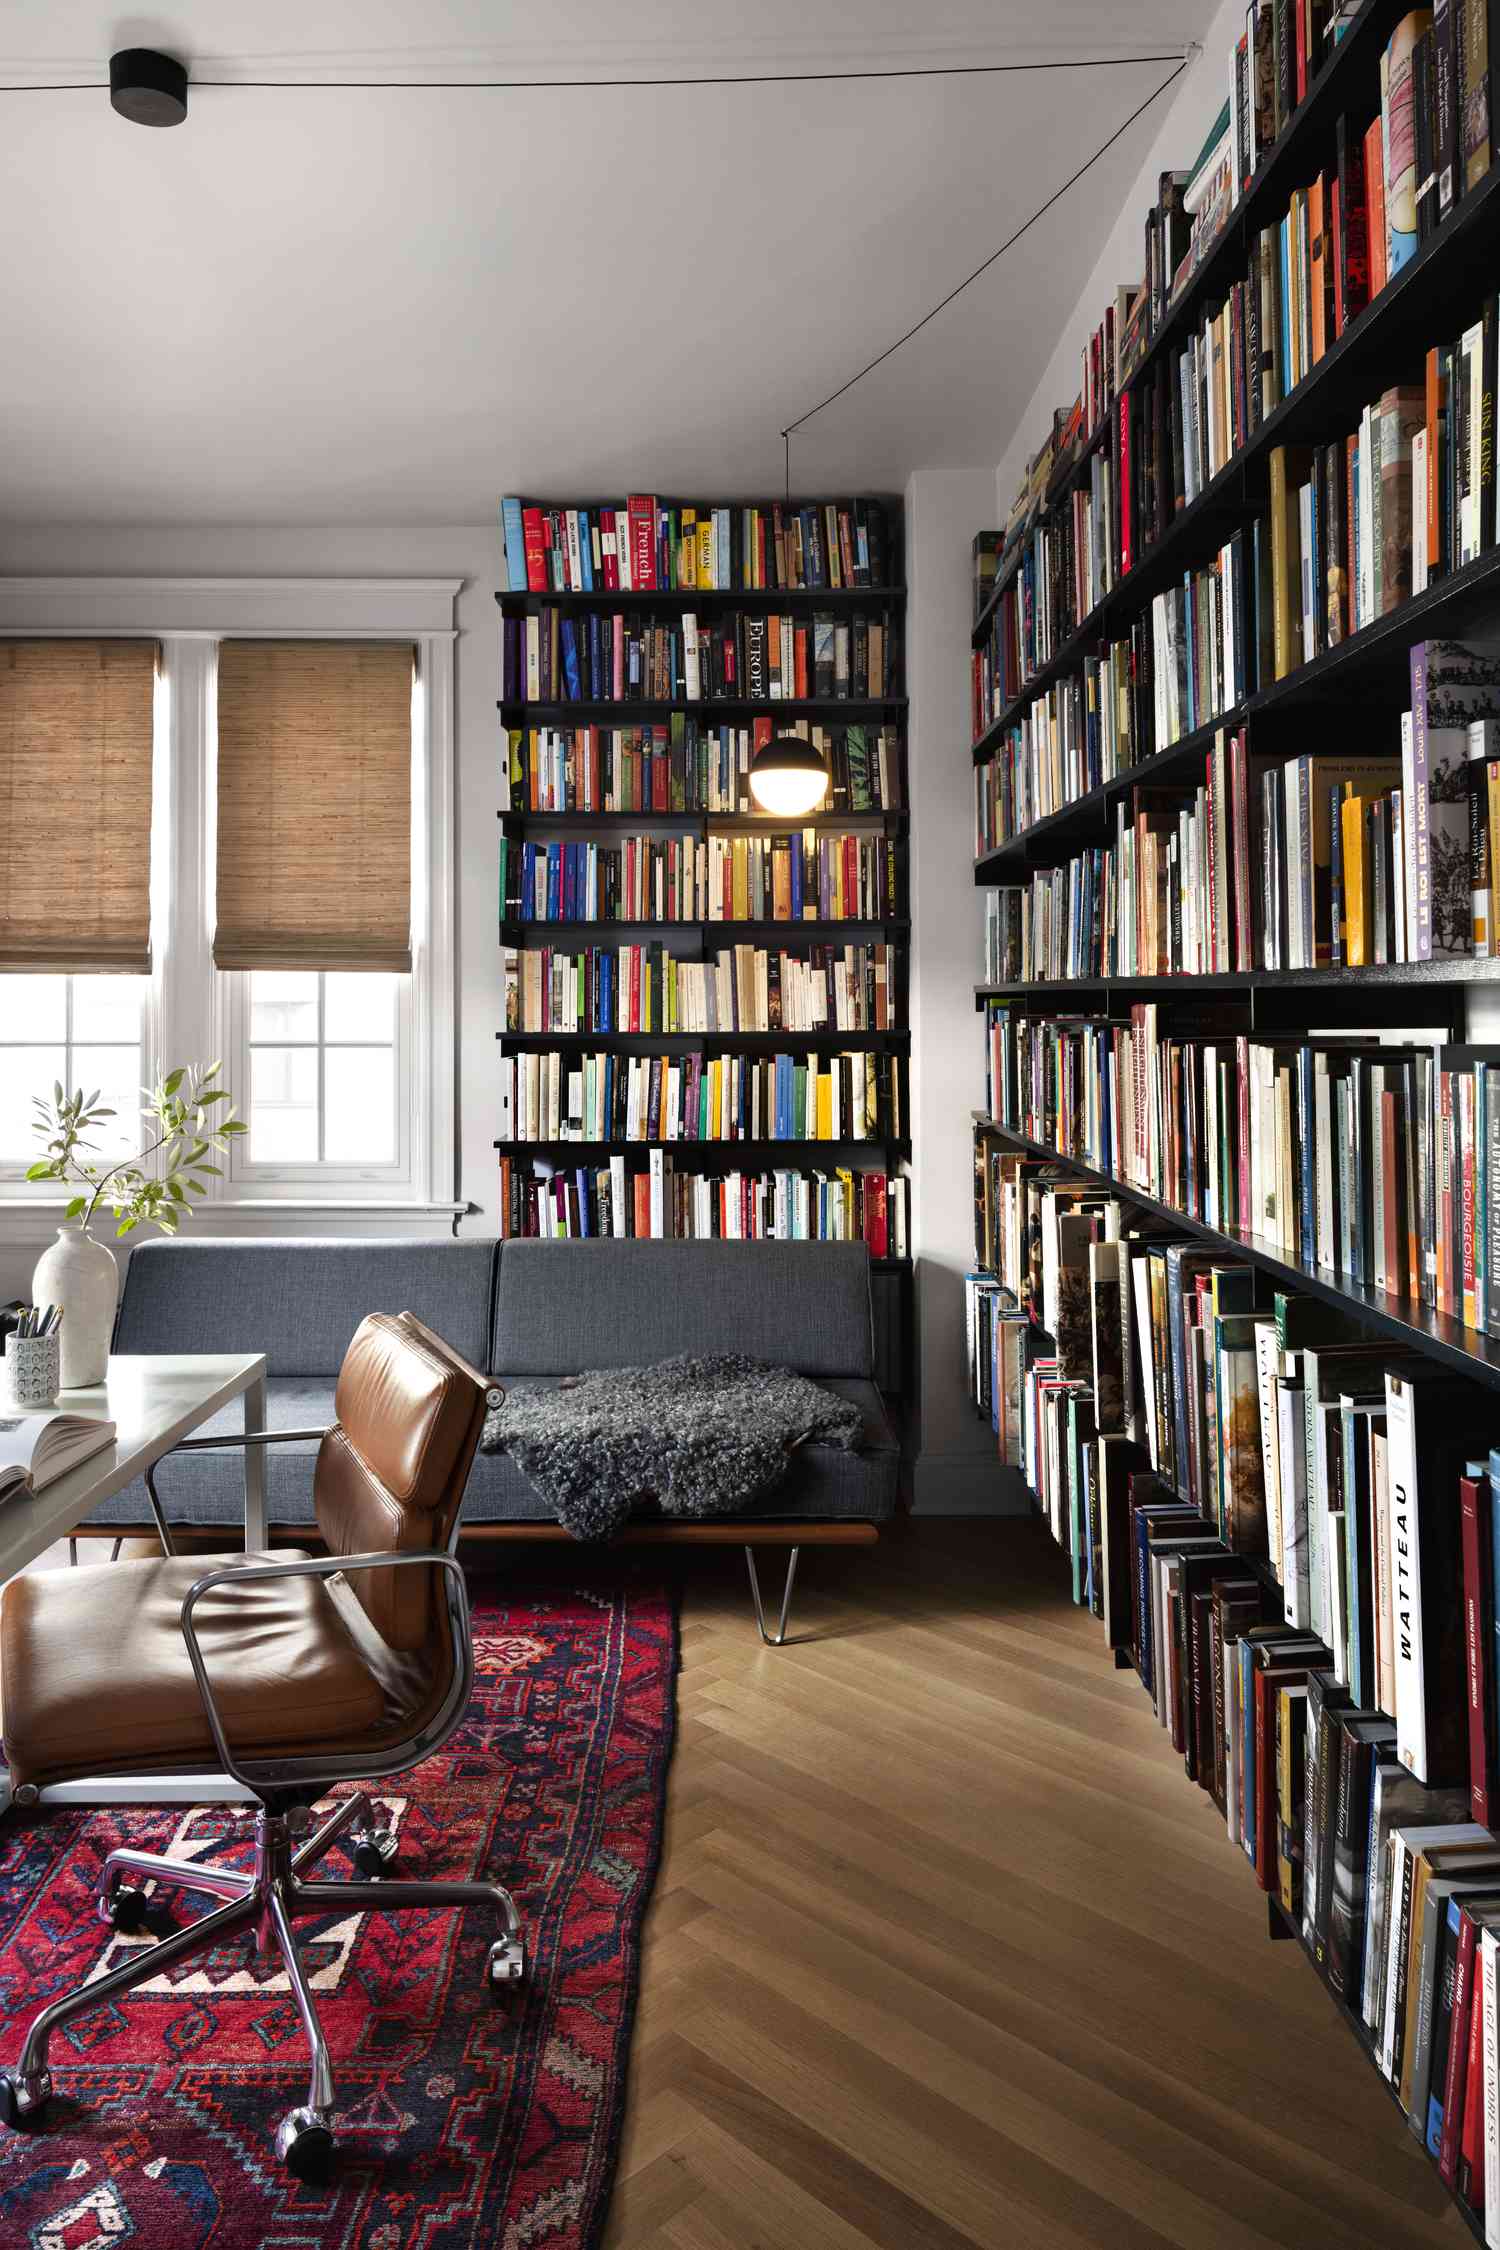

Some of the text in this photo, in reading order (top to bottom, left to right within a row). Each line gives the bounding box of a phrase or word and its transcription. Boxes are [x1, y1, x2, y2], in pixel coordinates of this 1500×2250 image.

[1480, 391, 1493, 487] SUN KING
[639, 520, 653, 580] French
[702, 530, 710, 568] GERMAN
[1374, 517, 1383, 574] SOCIETY
[750, 620, 765, 698] EUROPE
[1415, 663, 1429, 925] LE ROI EST MORT Louis XIV 1715
[1478, 826, 1487, 879] et Dieu
[1492, 1142, 1500, 1208] AUTONOMY
[600, 1199, 609, 1235] Freedom
[1463, 1179, 1473, 1280] BOURGEOISIE
[1495, 1212, 1500, 1225] OF
[1492, 1227, 1500, 1288] PLEASURE
[1119, 1252, 1129, 1351] RICHELIEU
[1307, 1448, 1315, 1510] WATTEAU
[1138, 1546, 1146, 1597] BECOMING
[1395, 1483, 1412, 1662] WATTEAU
[1191, 1617, 1201, 1705] FRAGONARD
[1212, 1603, 1223, 1725] FRAGONARD
[1304, 1757, 1314, 1847] Bouchardon
[1455, 1963, 1465, 2006] CHAINS
[1486, 1960, 1494, 1997] THE
[1421, 1979, 1431, 2049] EMULATION
[1486, 2000, 1495, 2033] AGE
[1487, 2038, 1495, 2064] OF
[1487, 2065, 1496, 2146] UNDRESS
